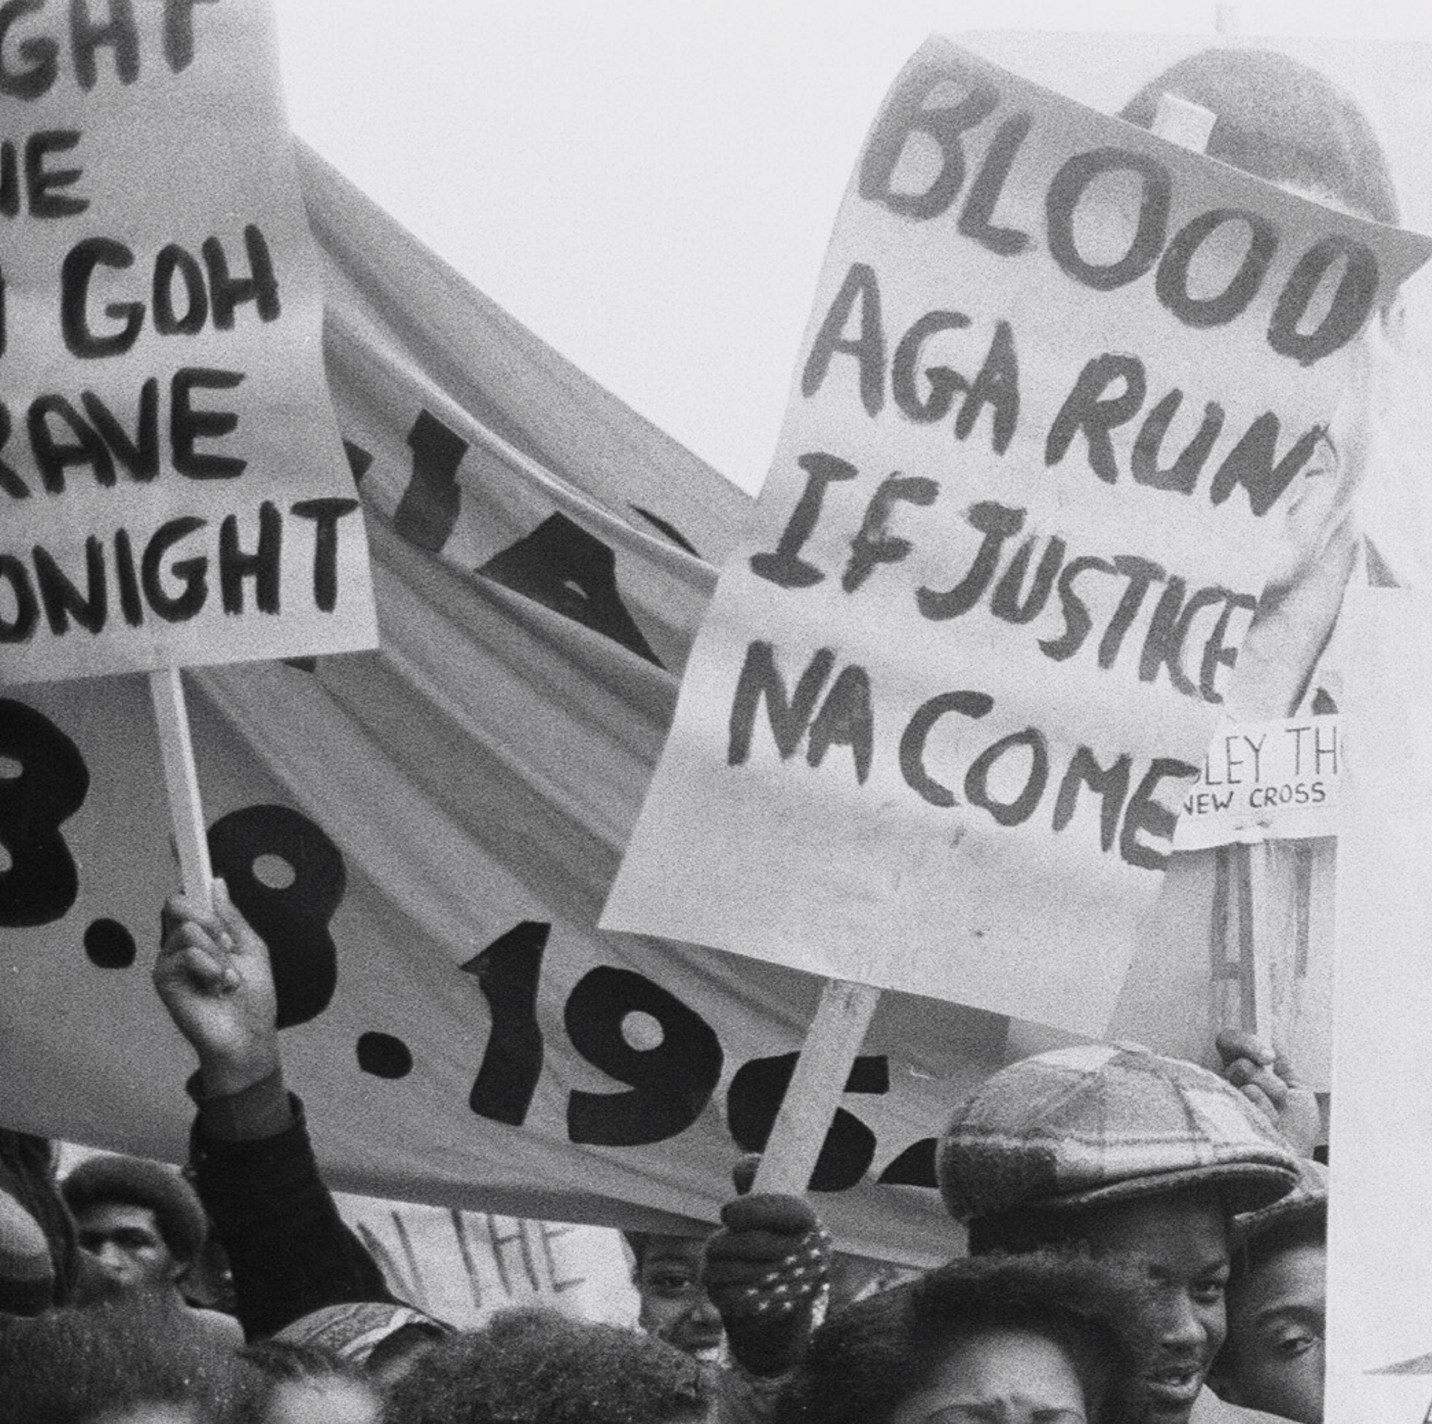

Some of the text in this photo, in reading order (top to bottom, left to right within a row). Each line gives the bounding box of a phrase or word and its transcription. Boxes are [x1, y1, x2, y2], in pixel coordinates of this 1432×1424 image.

[856, 56, 1382, 368] BLOOD
[60, 223, 281, 359] GOH
[800, 261, 1330, 518] AGA RUN
[750, 451, 941, 594] IF
[727, 639, 1201, 871] NA COME
[1193, 733, 1267, 785] LEY
[1249, 781, 1327, 809] CROSS
